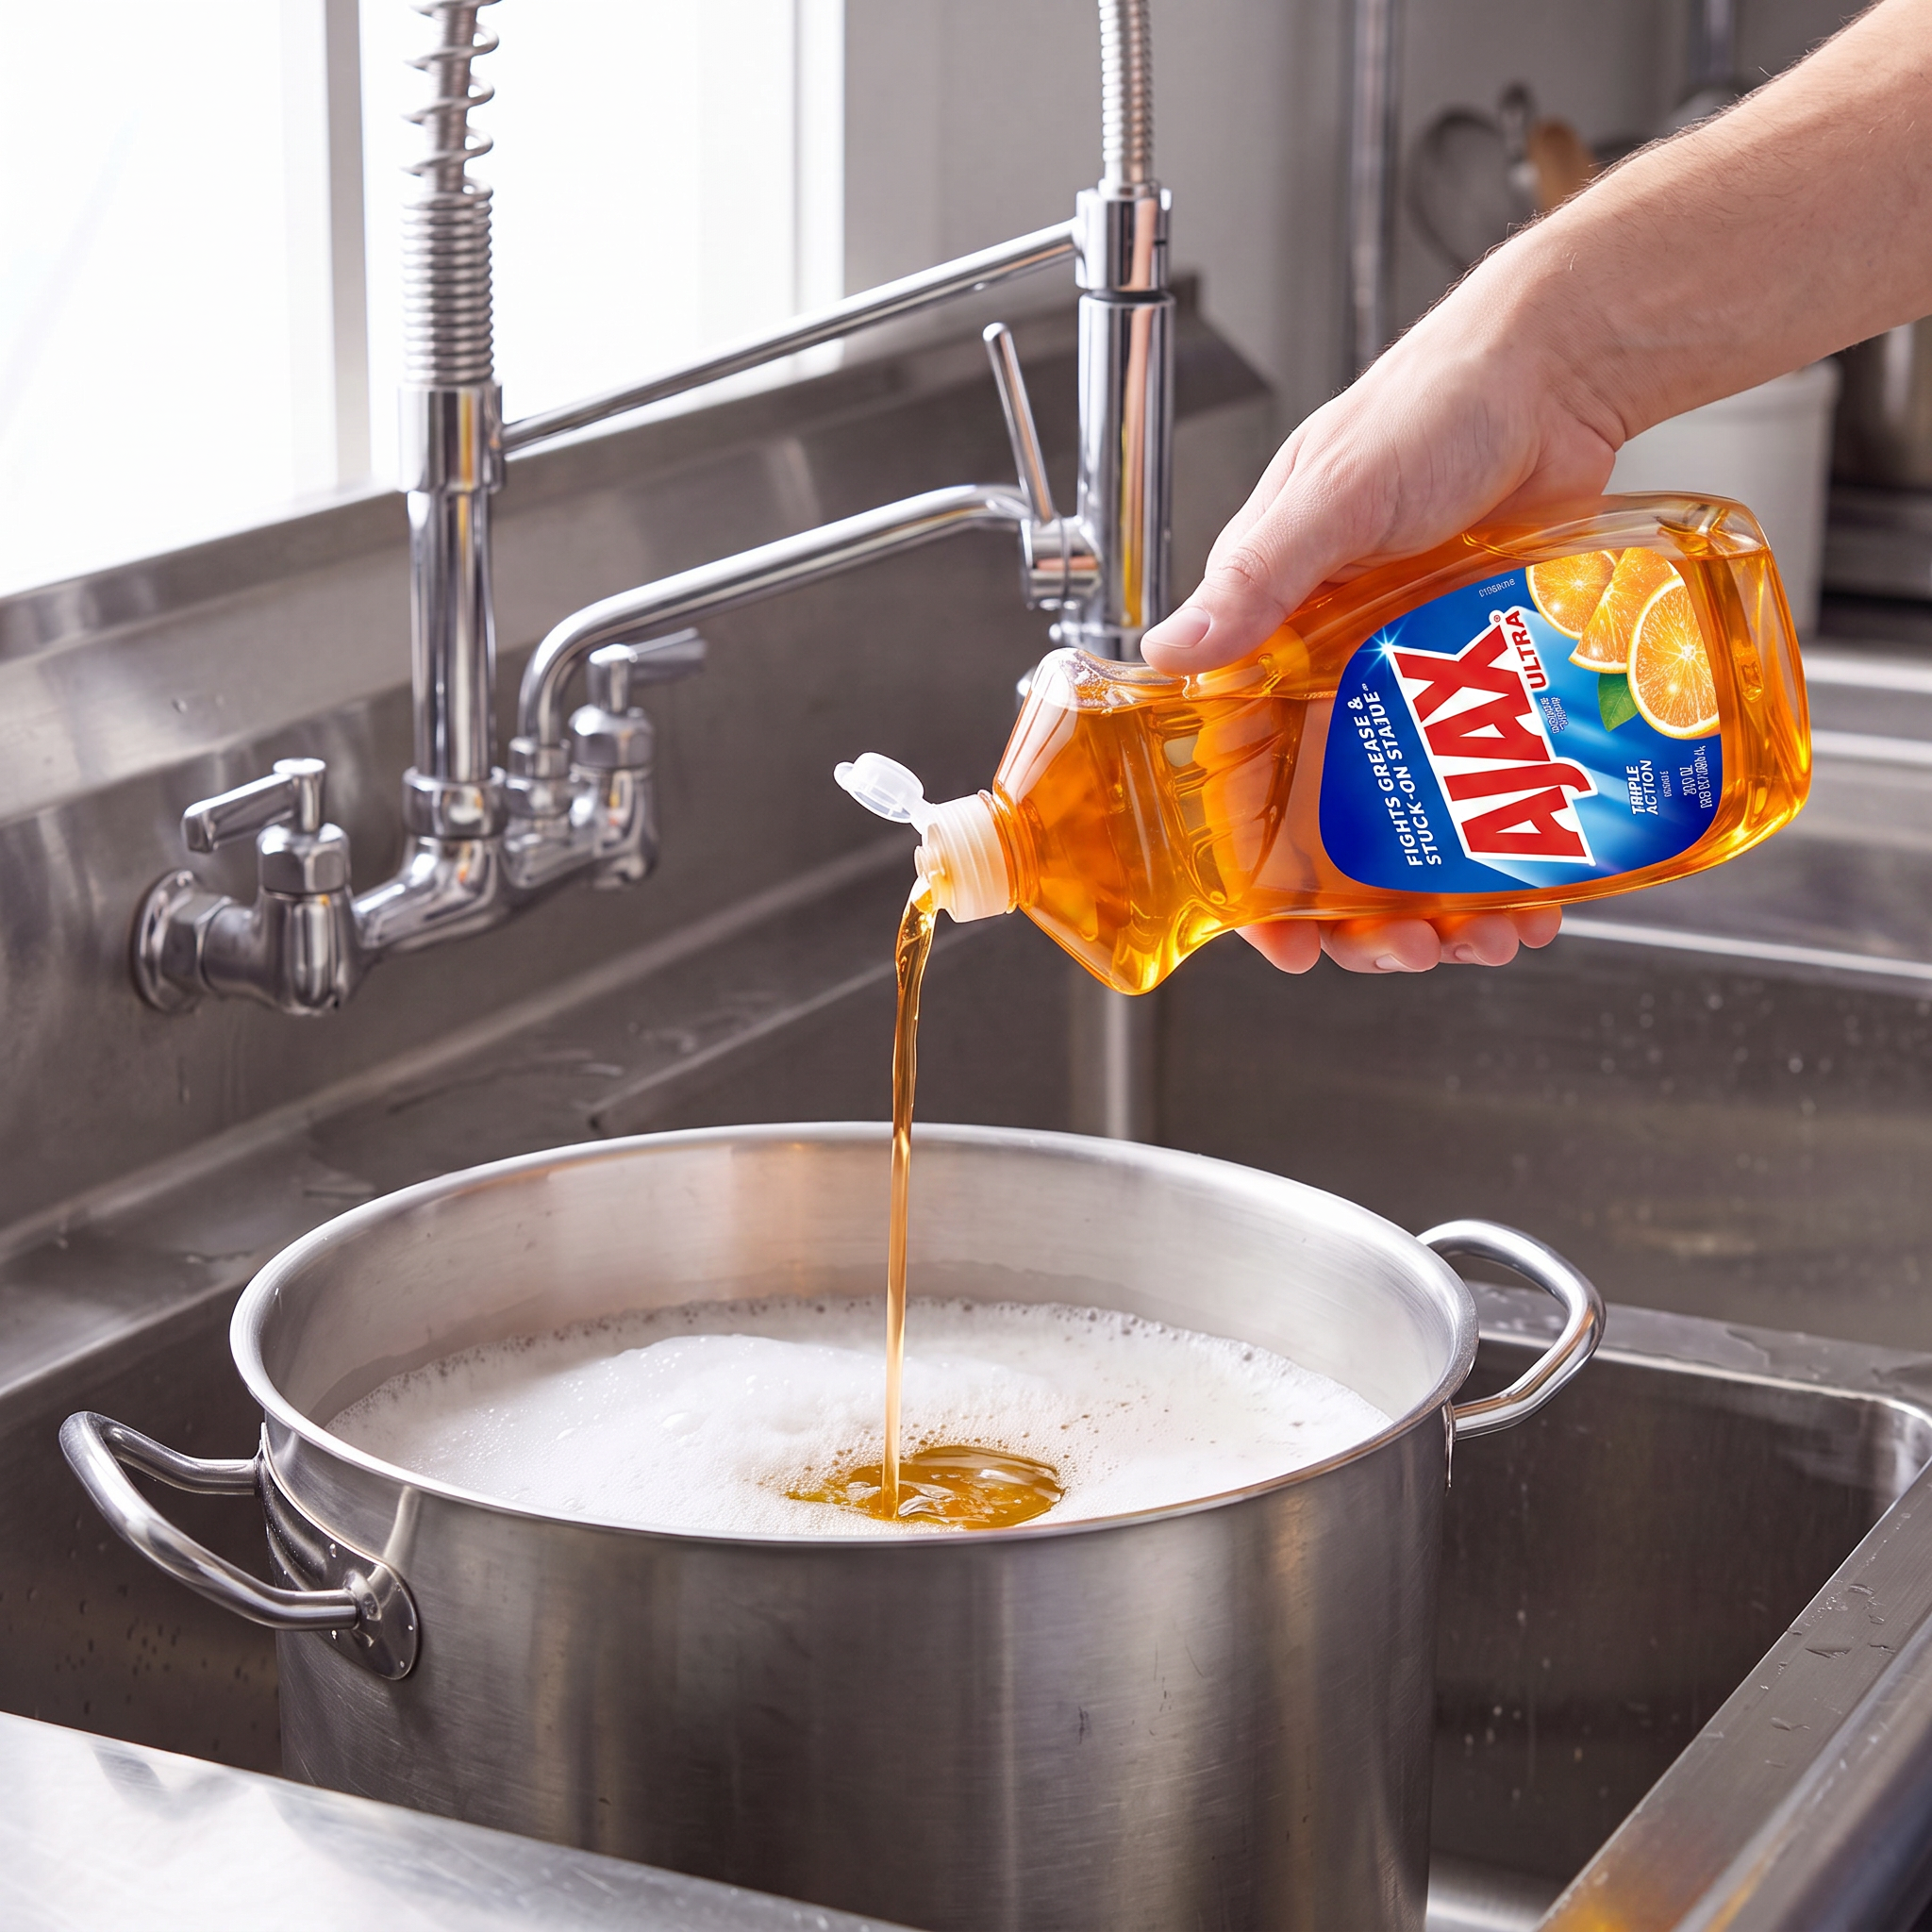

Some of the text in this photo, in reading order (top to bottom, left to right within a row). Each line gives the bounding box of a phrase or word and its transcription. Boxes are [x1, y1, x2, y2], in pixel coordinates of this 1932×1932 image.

[1506, 609, 1547, 690] ULTRA
[1347, 696, 1424, 866] FIGHTS GREASE &
[1392, 624, 1591, 858] AJAX
[1640, 759, 1658, 816] ACTION
[1392, 766, 1442, 866] STUCK-ON
